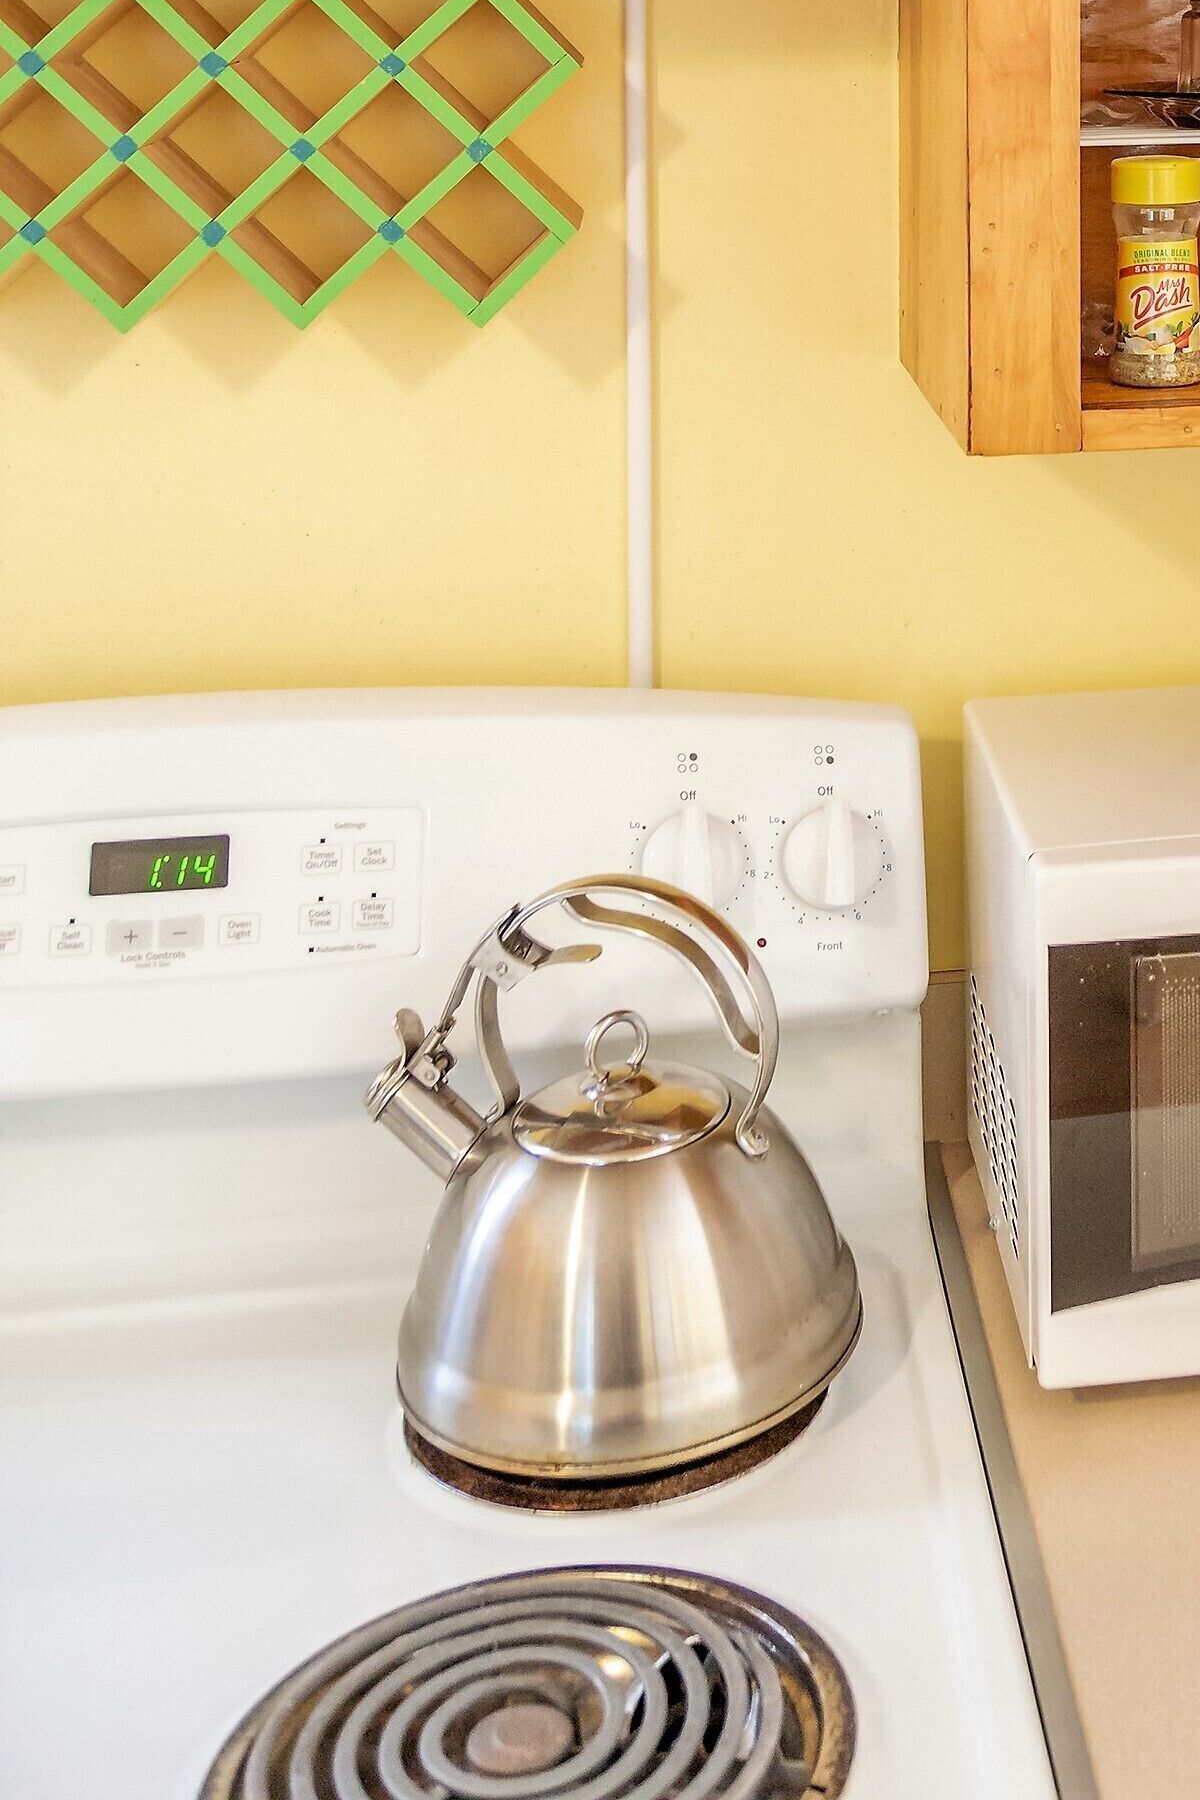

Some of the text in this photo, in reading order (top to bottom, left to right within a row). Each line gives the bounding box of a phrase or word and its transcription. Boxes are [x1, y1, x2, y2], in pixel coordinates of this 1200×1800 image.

[1134, 249, 1167, 258] ORIGINAL
[1130, 277, 1190, 319] Dash
[680, 790, 697, 800] Off
[817, 786, 834, 796] Off
[738, 813, 747, 822] Hi
[874, 808, 883, 818] Hi
[769, 815, 780, 824] Lo
[334, 822, 366, 831] Settings
[629, 821, 640, 830] Lo
[309, 851, 335, 859] Timer
[367, 847, 382, 856] Set
[305, 860, 338, 870] On/Off
[361, 857, 387, 866] Clock
[886, 863, 892, 872] 8
[749, 869, 756, 877] 8
[764, 872, 769, 880] 2
[360, 902, 386, 913] Delay
[308, 908, 332, 918] Cook
[363, 911, 384, 921] Time
[855, 911, 861, 920] 6
[227, 920, 252, 929] Oven
[309, 918, 331, 927] Time
[798, 917, 804, 925] 4
[62, 931, 81, 940] Self
[227, 929, 251, 940] Light
[56, 941, 84, 951] Clean
[316, 942, 377, 953] Automatic Oven
[817, 941, 843, 951] Front
[120, 950, 186, 963] Lock Controls
